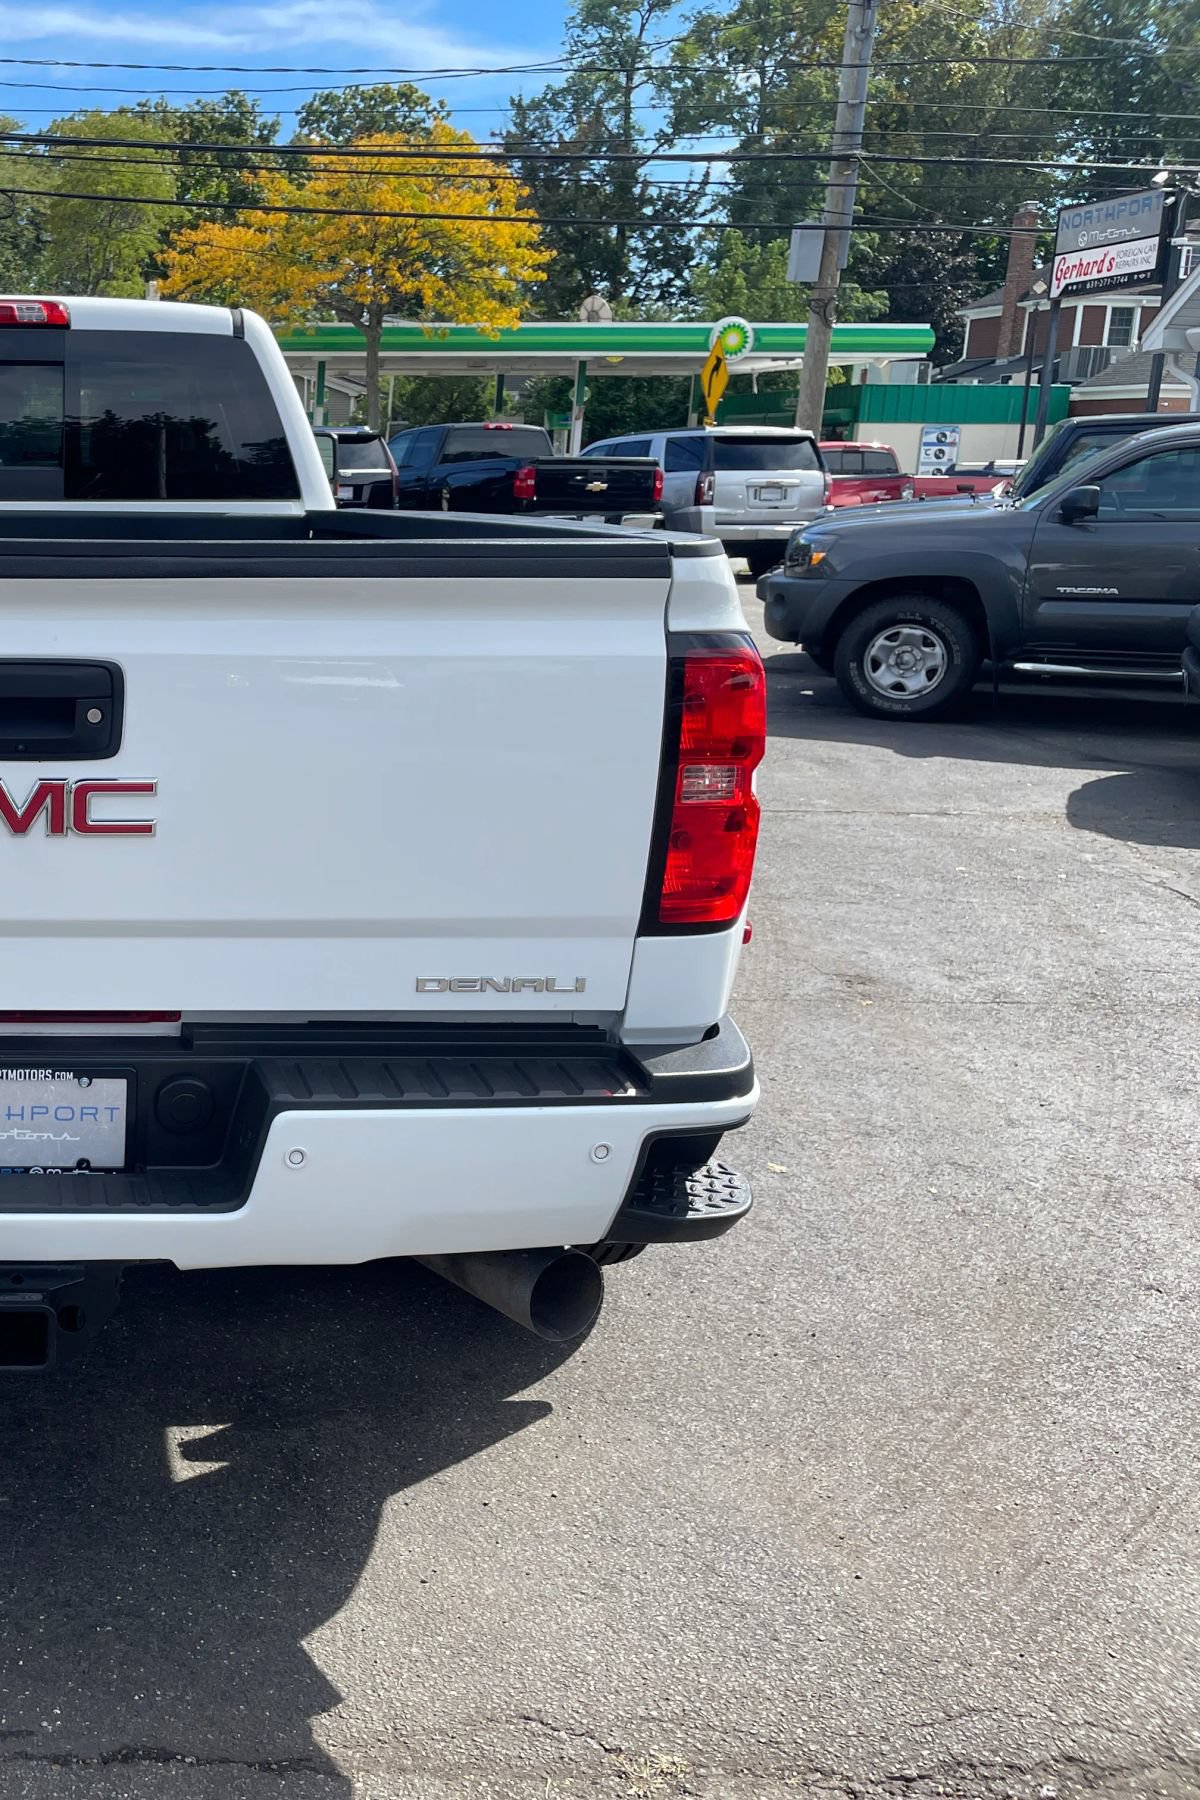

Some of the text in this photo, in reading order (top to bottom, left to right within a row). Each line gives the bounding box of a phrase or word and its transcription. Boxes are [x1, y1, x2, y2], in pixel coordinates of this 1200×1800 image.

[1060, 194, 1164, 232] NORTHPORT
[1089, 226, 1142, 241] Motors
[1116, 244, 1157, 260] FOREIGN CAR
[1055, 250, 1116, 290] Gerhard's
[1115, 258, 1139, 270] REPAIRS
[1086, 275, 1129, 289] 631-271-7744
[1056, 586, 1119, 595] TACOMA
[415, 976, 587, 993] DENALI
